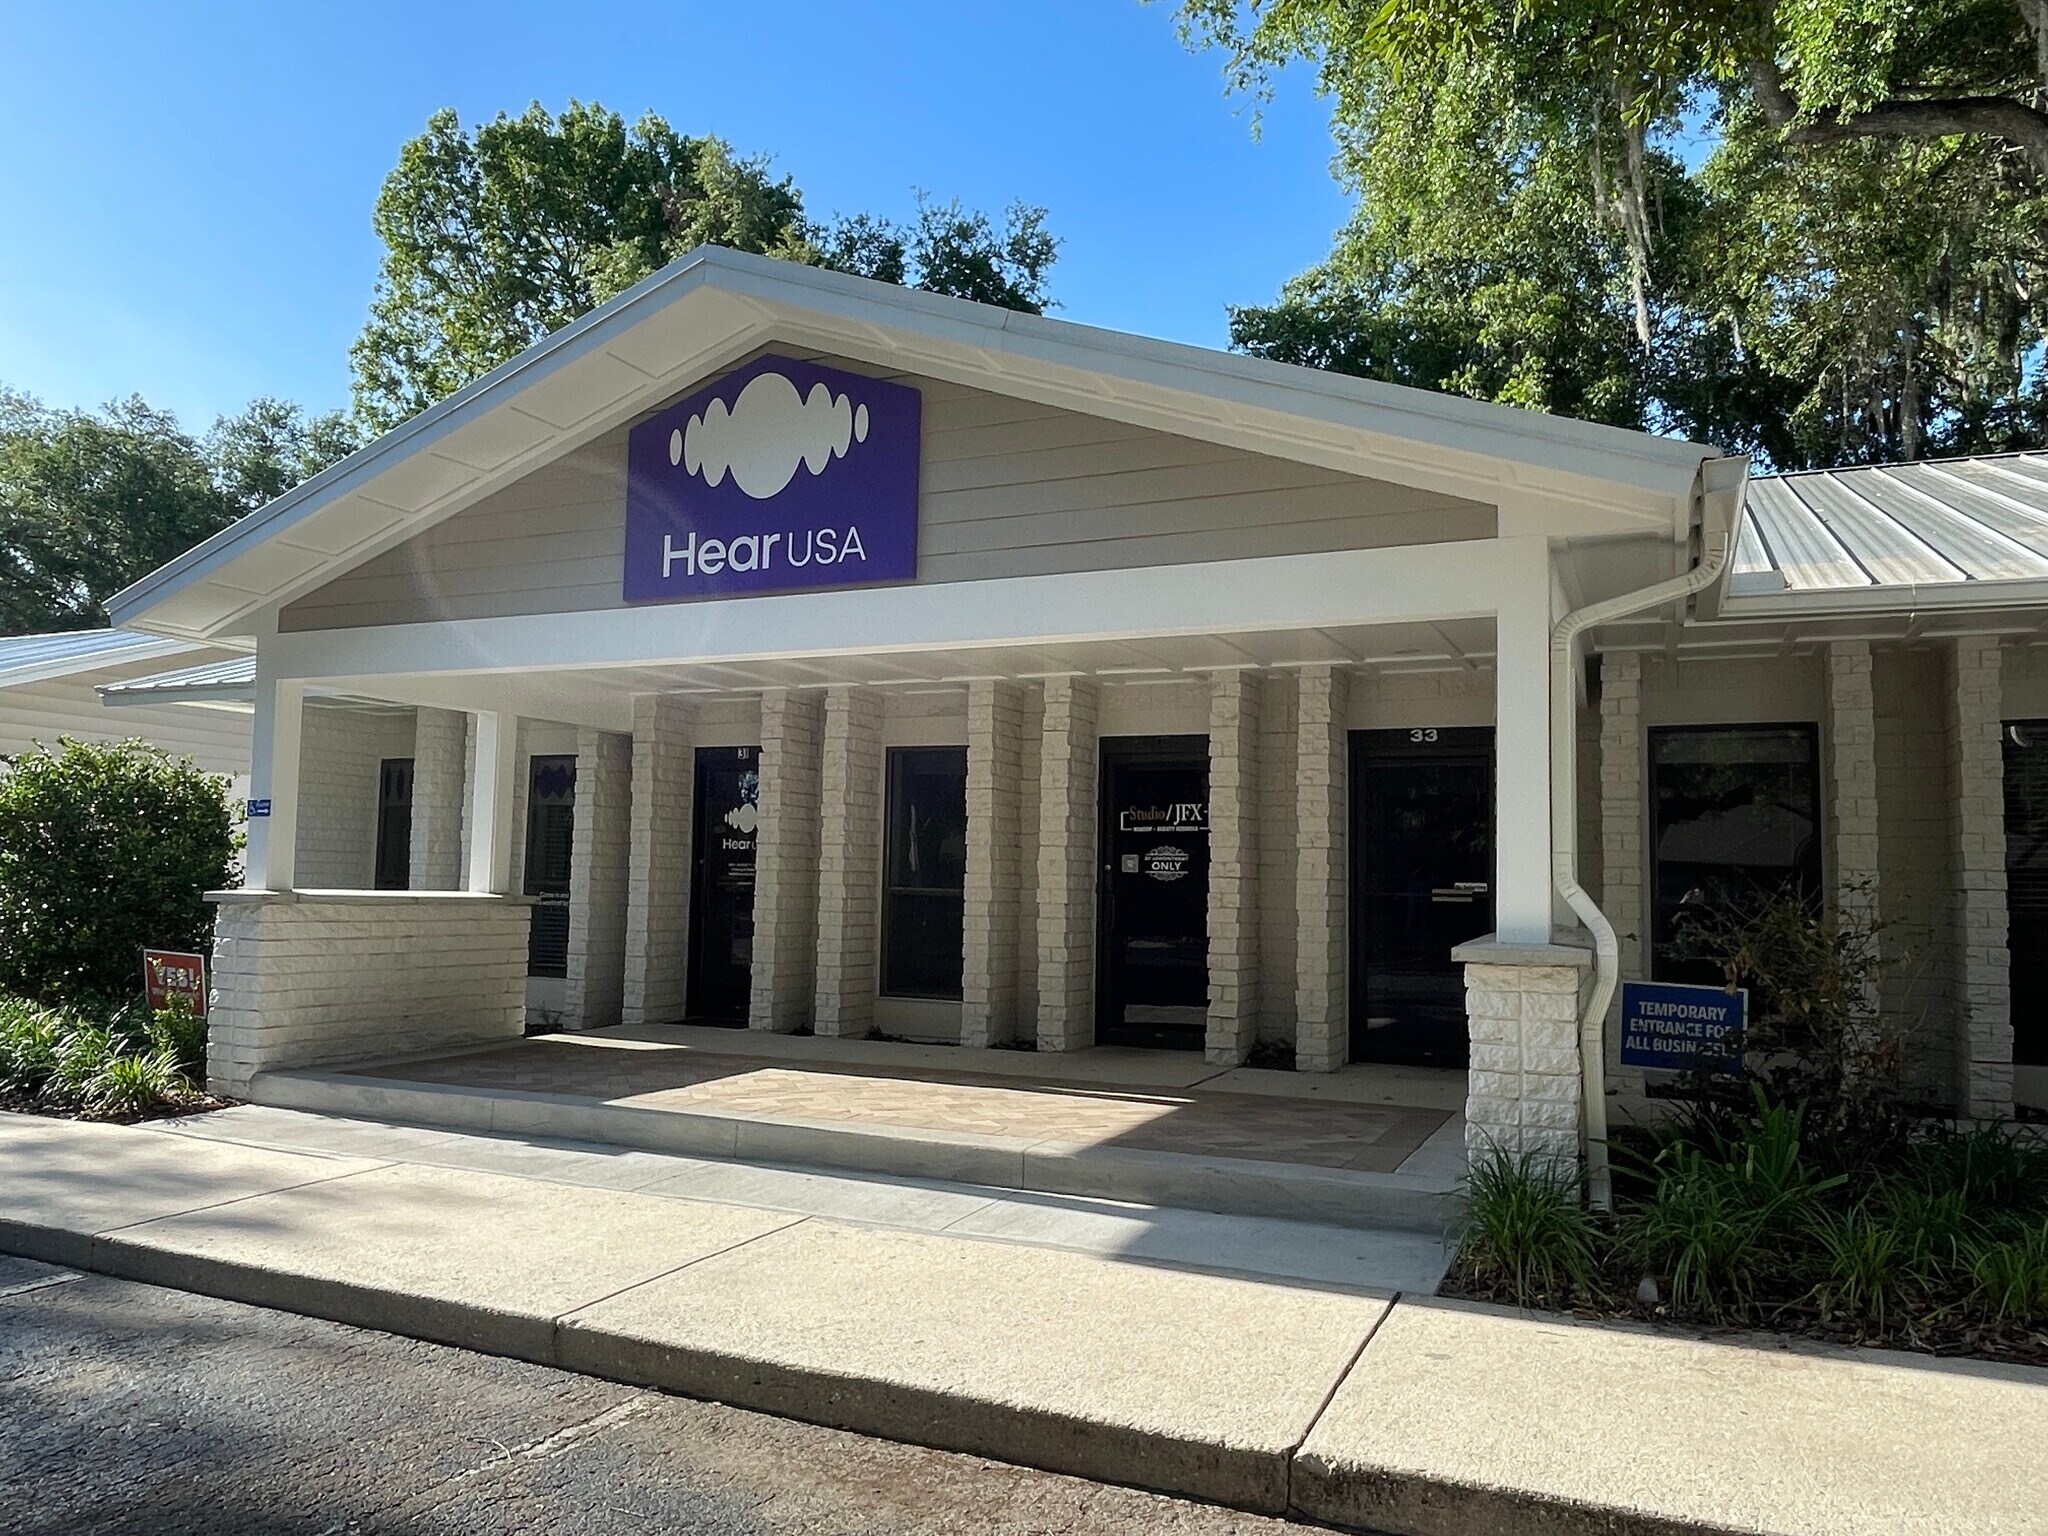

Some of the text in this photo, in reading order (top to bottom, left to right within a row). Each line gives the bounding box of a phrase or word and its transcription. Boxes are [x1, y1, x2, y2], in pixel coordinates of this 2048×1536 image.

[662, 526, 866, 578] Hear USA
[1409, 728, 1438, 742] 33
[722, 838, 751, 850] Hear
[1151, 861, 1182, 871] ONLY
[1638, 1001, 1728, 1021] TEMPORARY
[1630, 1018, 1703, 1037] ENTRANCE
[1625, 1035, 1650, 1051] ALL
